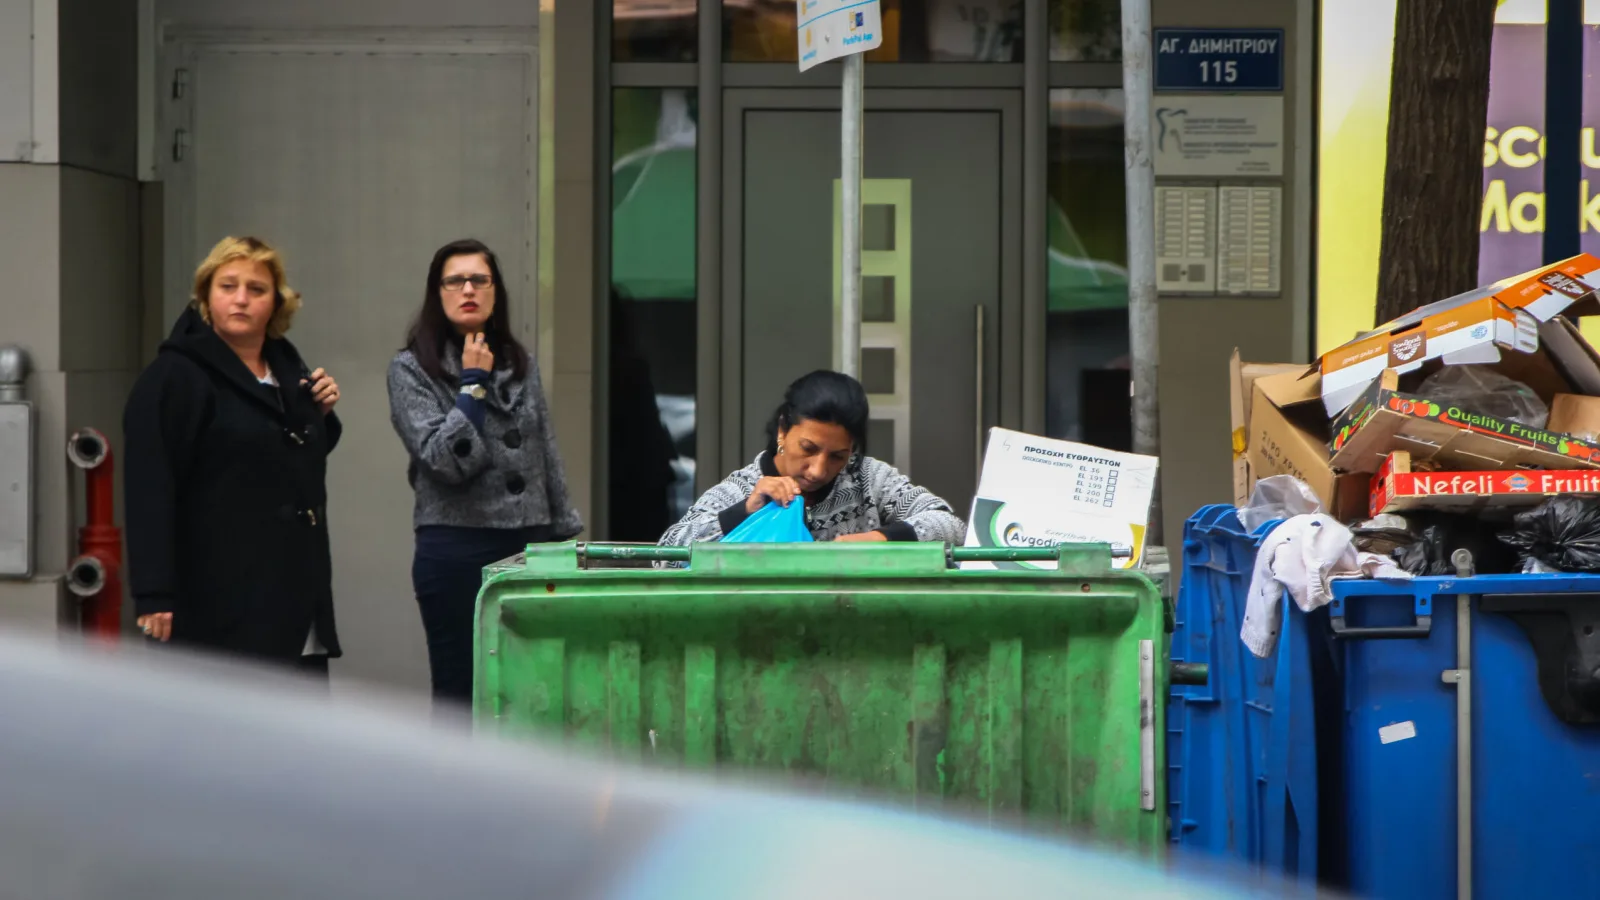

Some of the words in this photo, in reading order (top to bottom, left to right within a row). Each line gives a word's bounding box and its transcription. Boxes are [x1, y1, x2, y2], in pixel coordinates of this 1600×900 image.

[1160, 38, 1184, 54] ΑΓ.
[1188, 38, 1277, 54] ΔΗΜΗΤΡΙΟΥ
[1200, 61, 1237, 83] 115
[1447, 406, 1505, 433] Quality
[1510, 424, 1558, 445] Fruits
[1024, 446, 1064, 458] ΠΡΟΣΟΧΗ
[1066, 453, 1121, 468] ΕΥΘΡΑΥΣΤΟΝ
[1086, 489, 1100, 497] 200
[1413, 475, 1493, 494] Nefeli
[1541, 474, 1600, 493] Fruit
